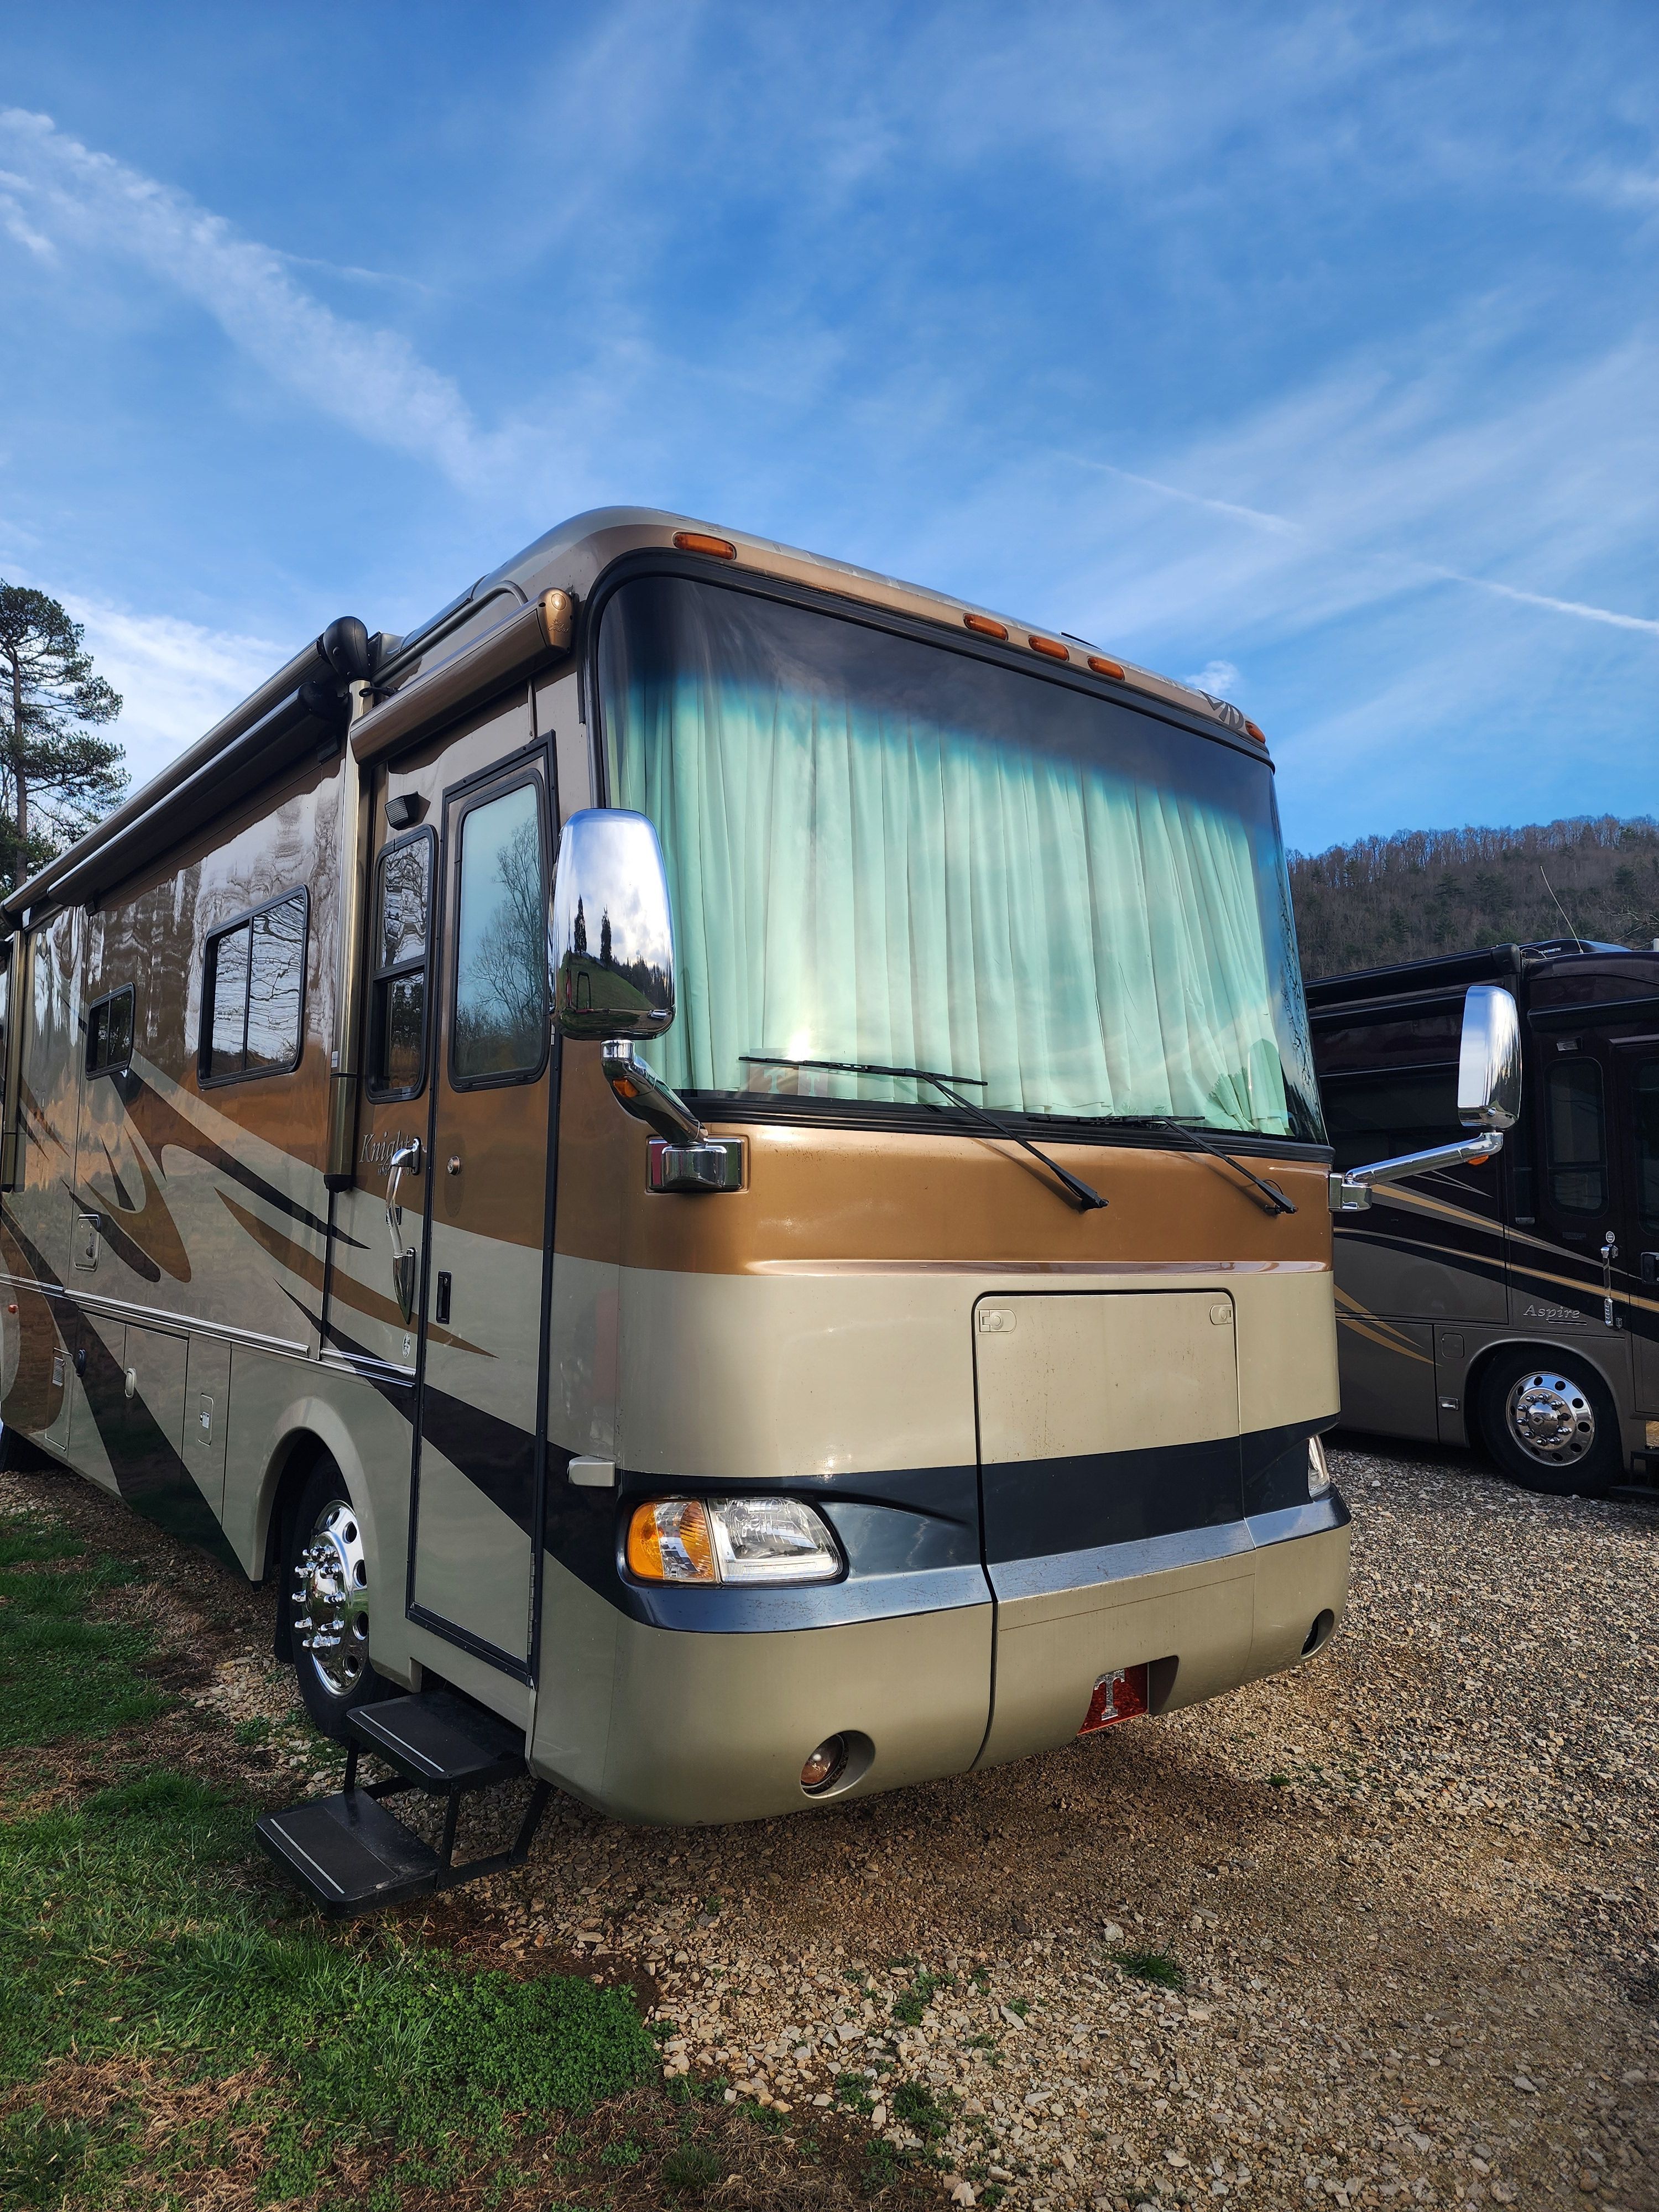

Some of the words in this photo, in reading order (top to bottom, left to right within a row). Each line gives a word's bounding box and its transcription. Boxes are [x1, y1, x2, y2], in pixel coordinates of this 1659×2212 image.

[764, 1069, 786, 1094] T
[1522, 1304, 1580, 1321] Aspire
[1093, 1668, 1126, 1721] T
